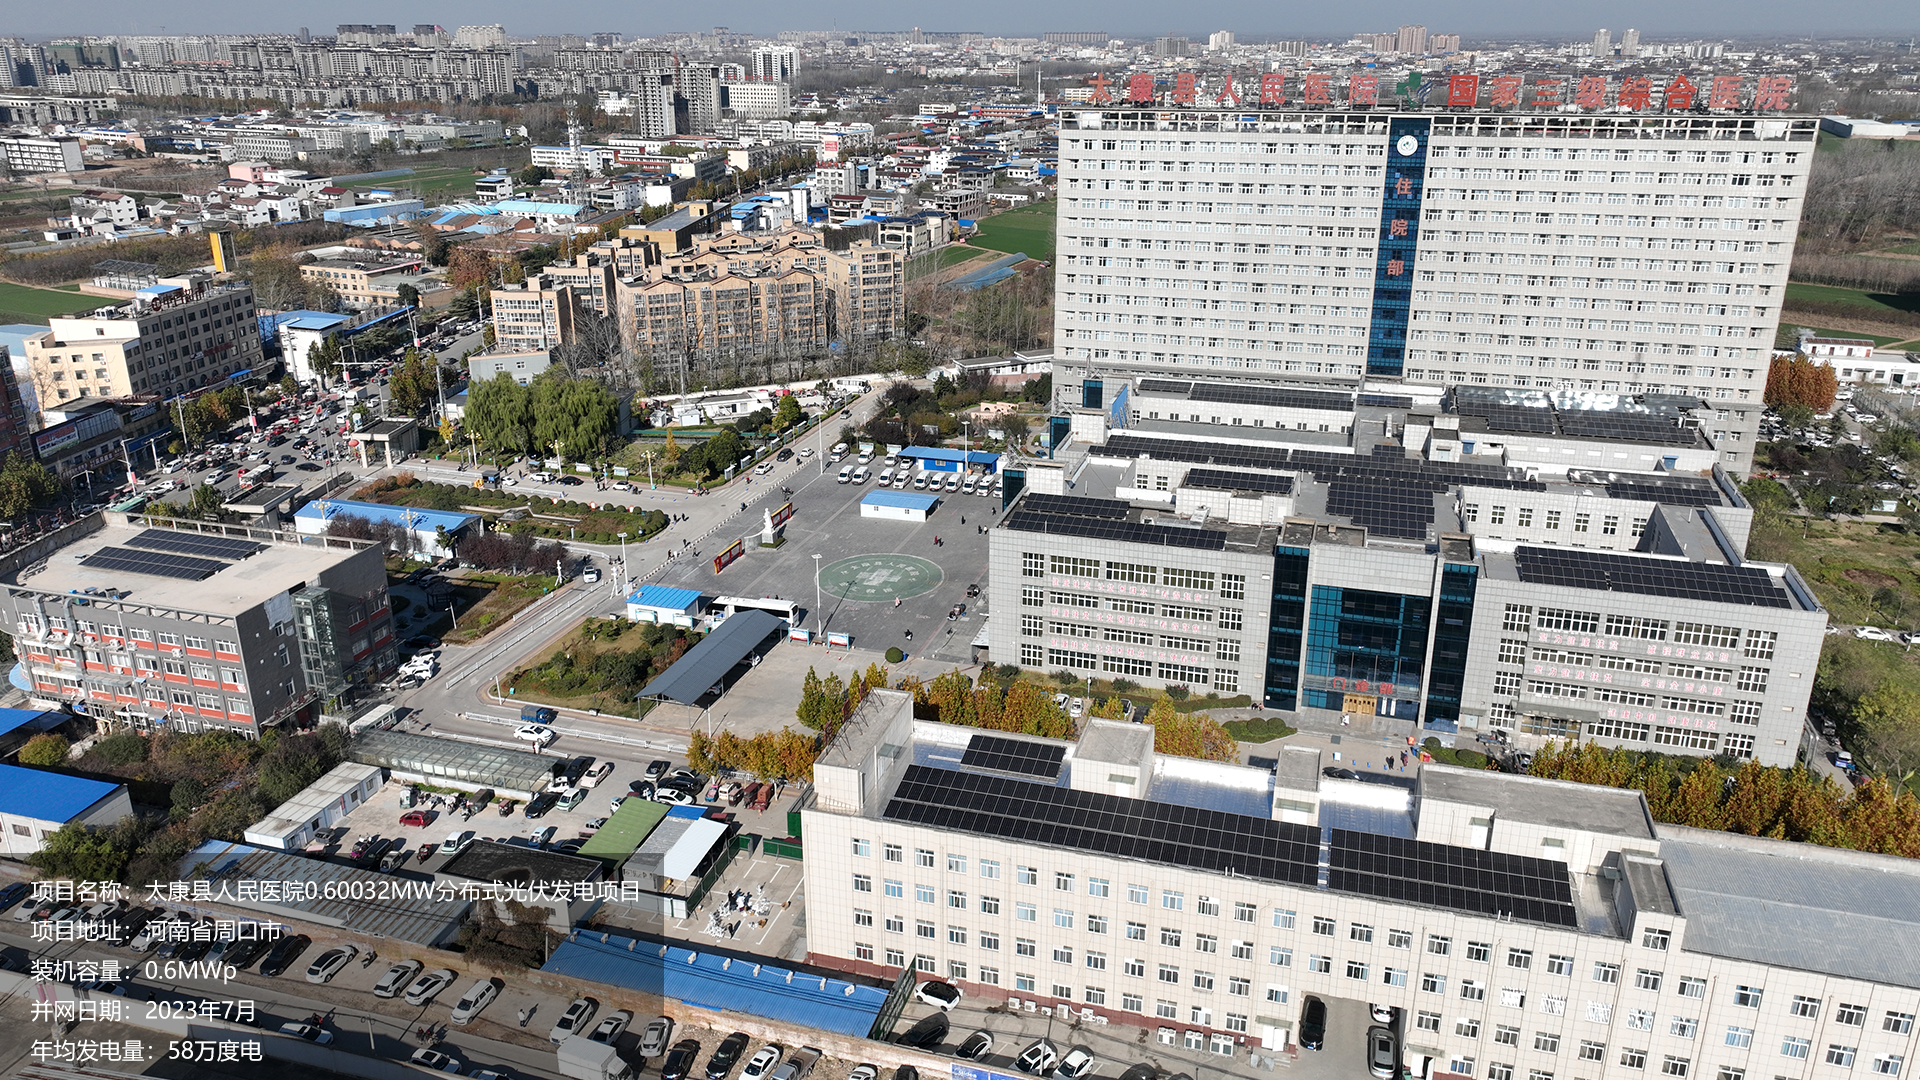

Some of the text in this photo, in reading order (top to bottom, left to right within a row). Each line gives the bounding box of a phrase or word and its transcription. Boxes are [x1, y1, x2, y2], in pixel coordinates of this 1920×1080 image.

[1088, 72, 1792, 111] 太康县人民医院 国家三级综合医院
[1386, 177, 1413, 277] 住院部
[1332, 676, 1394, 695] 门诊部
